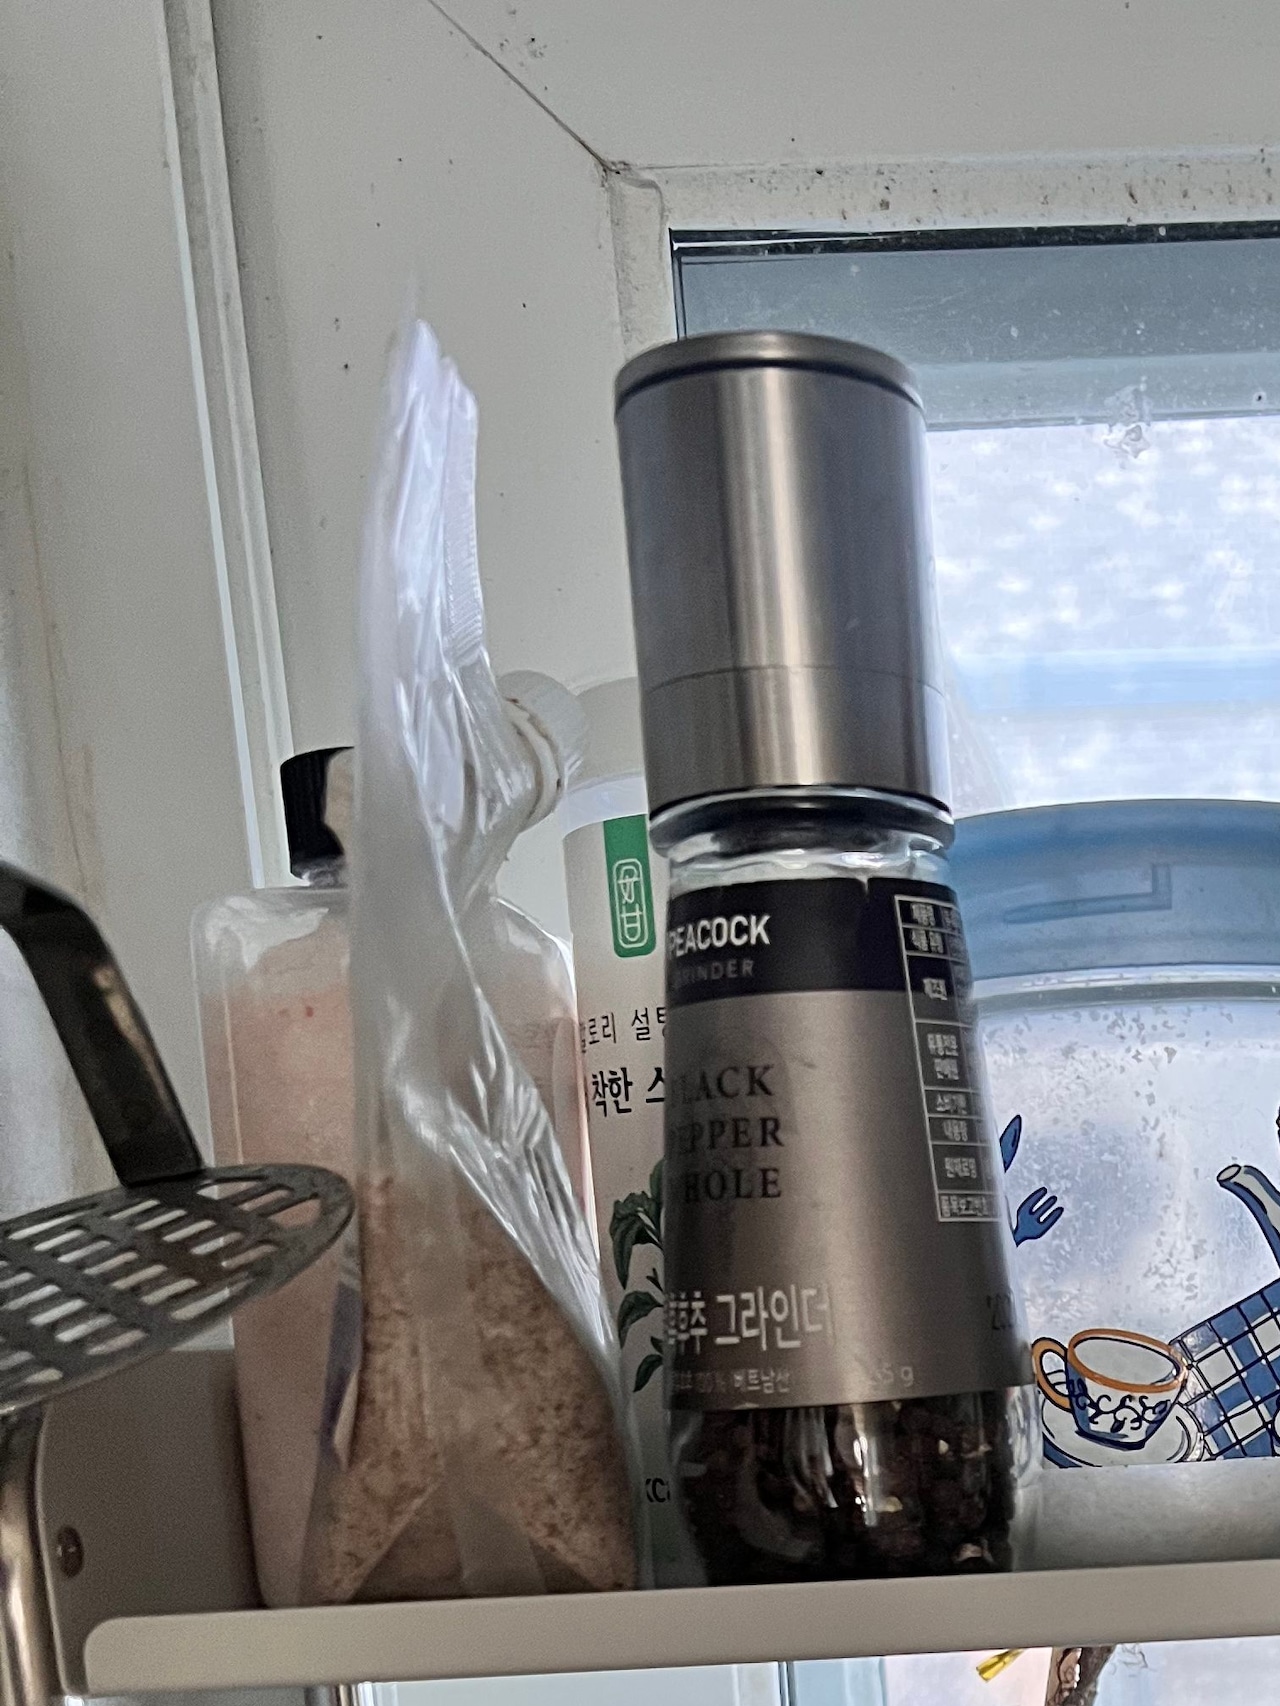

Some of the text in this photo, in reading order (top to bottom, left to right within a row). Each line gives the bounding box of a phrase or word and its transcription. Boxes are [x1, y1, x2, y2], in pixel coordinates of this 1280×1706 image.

[669, 914, 771, 958] PEACOCK
[592, 1067, 633, 1117] 착한
[715, 1283, 836, 1351] 그라인더
